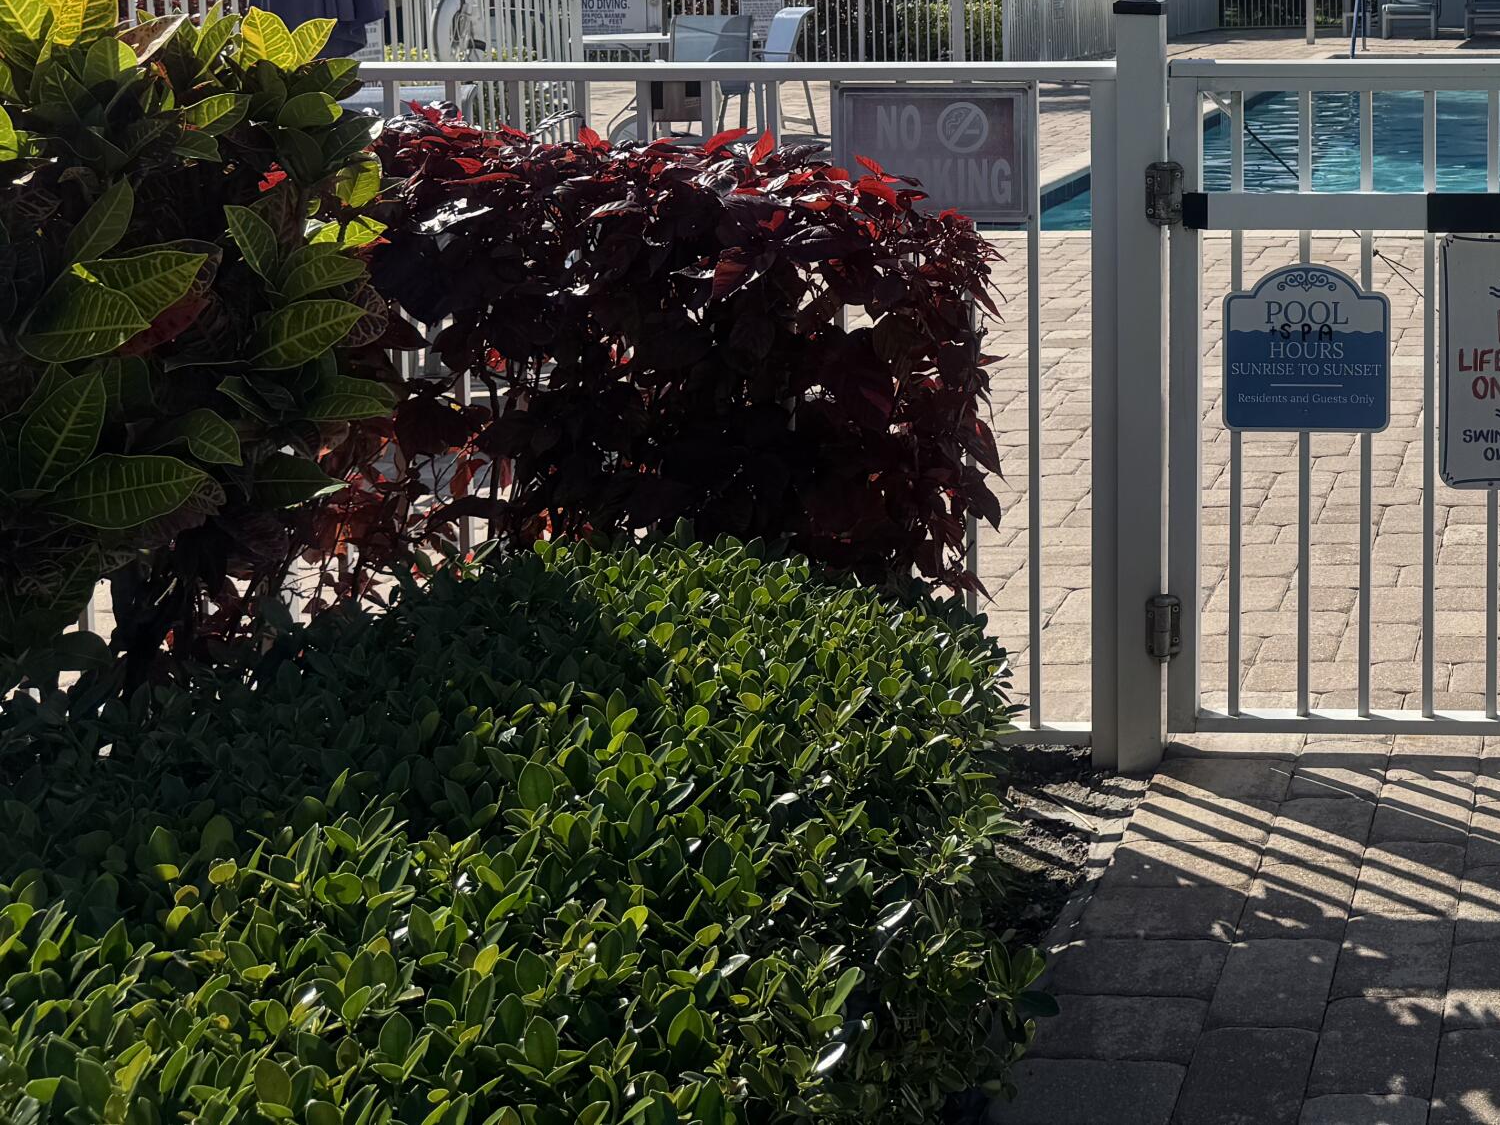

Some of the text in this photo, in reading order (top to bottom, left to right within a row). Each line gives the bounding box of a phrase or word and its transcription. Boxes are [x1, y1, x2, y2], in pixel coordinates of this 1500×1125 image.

[876, 104, 922, 150] NO
[1265, 300, 1349, 325] POOL
[1270, 342, 1344, 359] HOURS
[1231, 362, 1382, 377] SUNRISE TO SUNSET
[1238, 393, 1375, 407] Residents and Guests Only
